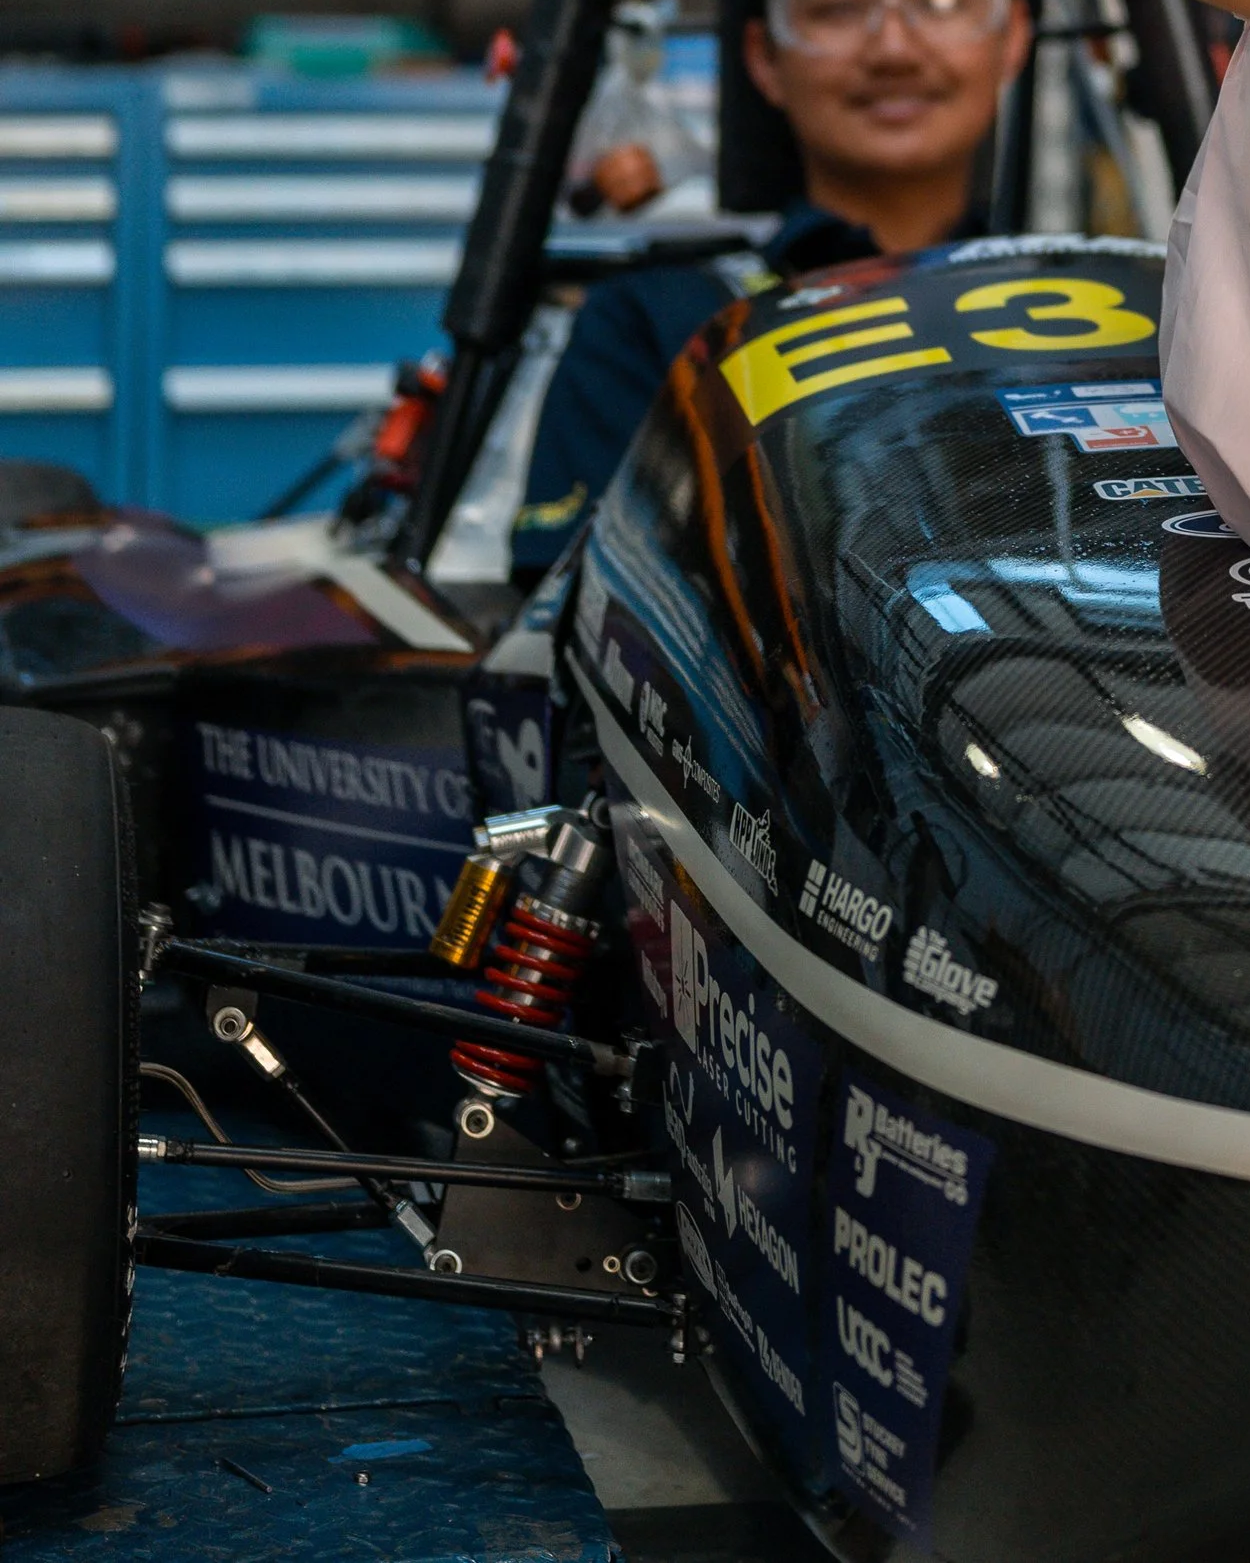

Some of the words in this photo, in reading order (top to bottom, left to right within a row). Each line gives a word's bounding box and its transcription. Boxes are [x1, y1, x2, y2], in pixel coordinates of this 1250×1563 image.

[195, 720, 255, 782] THE
[256, 734, 431, 814] UNIVERSITY
[815, 909, 880, 962] ENGINEERING
[821, 871, 893, 942] HARGO
[920, 945, 999, 1009] Glove
[692, 926, 794, 1130] Precise
[695, 1035, 730, 1101] LASER
[734, 1088, 798, 1175] CUTTING
[874, 1102, 969, 1177] Batteries
[736, 1184, 800, 1296] HEXAGON
[833, 1205, 948, 1327] PROLEC
